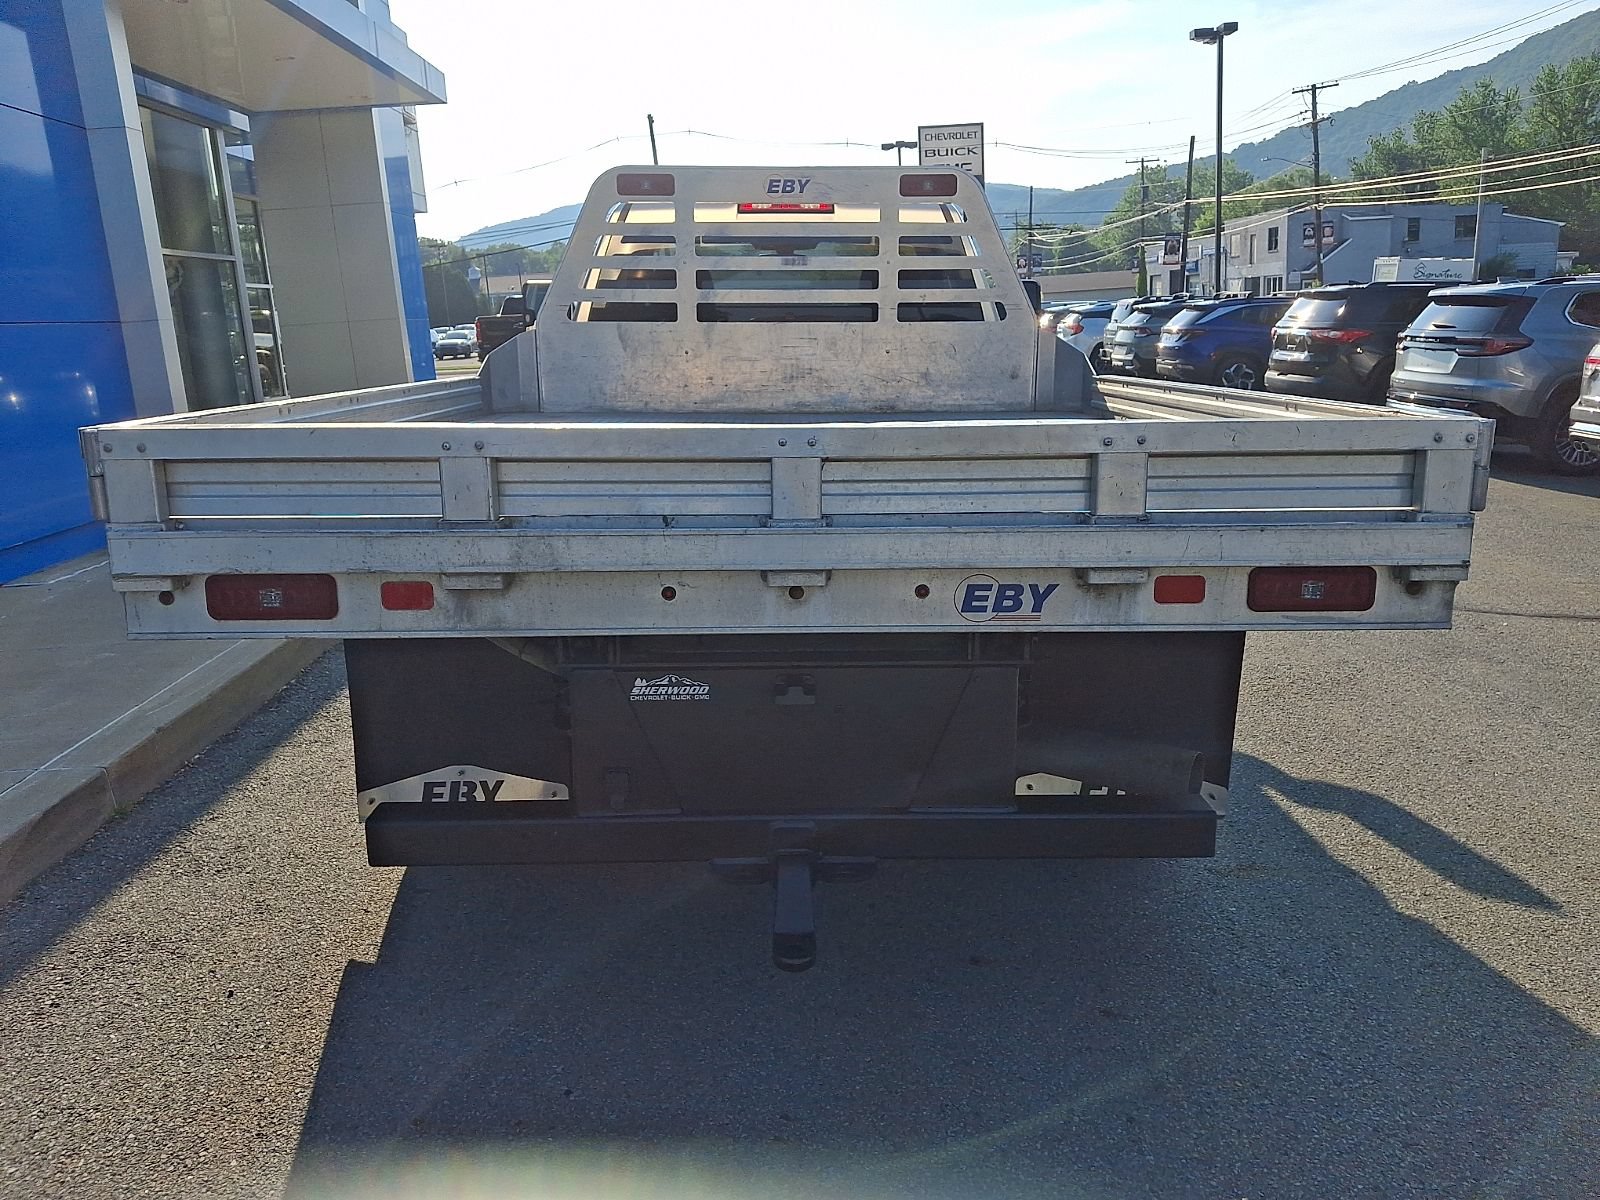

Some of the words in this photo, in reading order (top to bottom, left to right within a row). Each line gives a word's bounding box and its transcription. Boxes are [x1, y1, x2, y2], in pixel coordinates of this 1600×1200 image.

[924, 131, 978, 141] CHEVROLET
[924, 147, 978, 157] BUICK
[767, 179, 811, 193] EBY
[1413, 262, 1462, 279] Signature
[961, 583, 1060, 613] EBY
[630, 686, 710, 695] SHERWOOD
